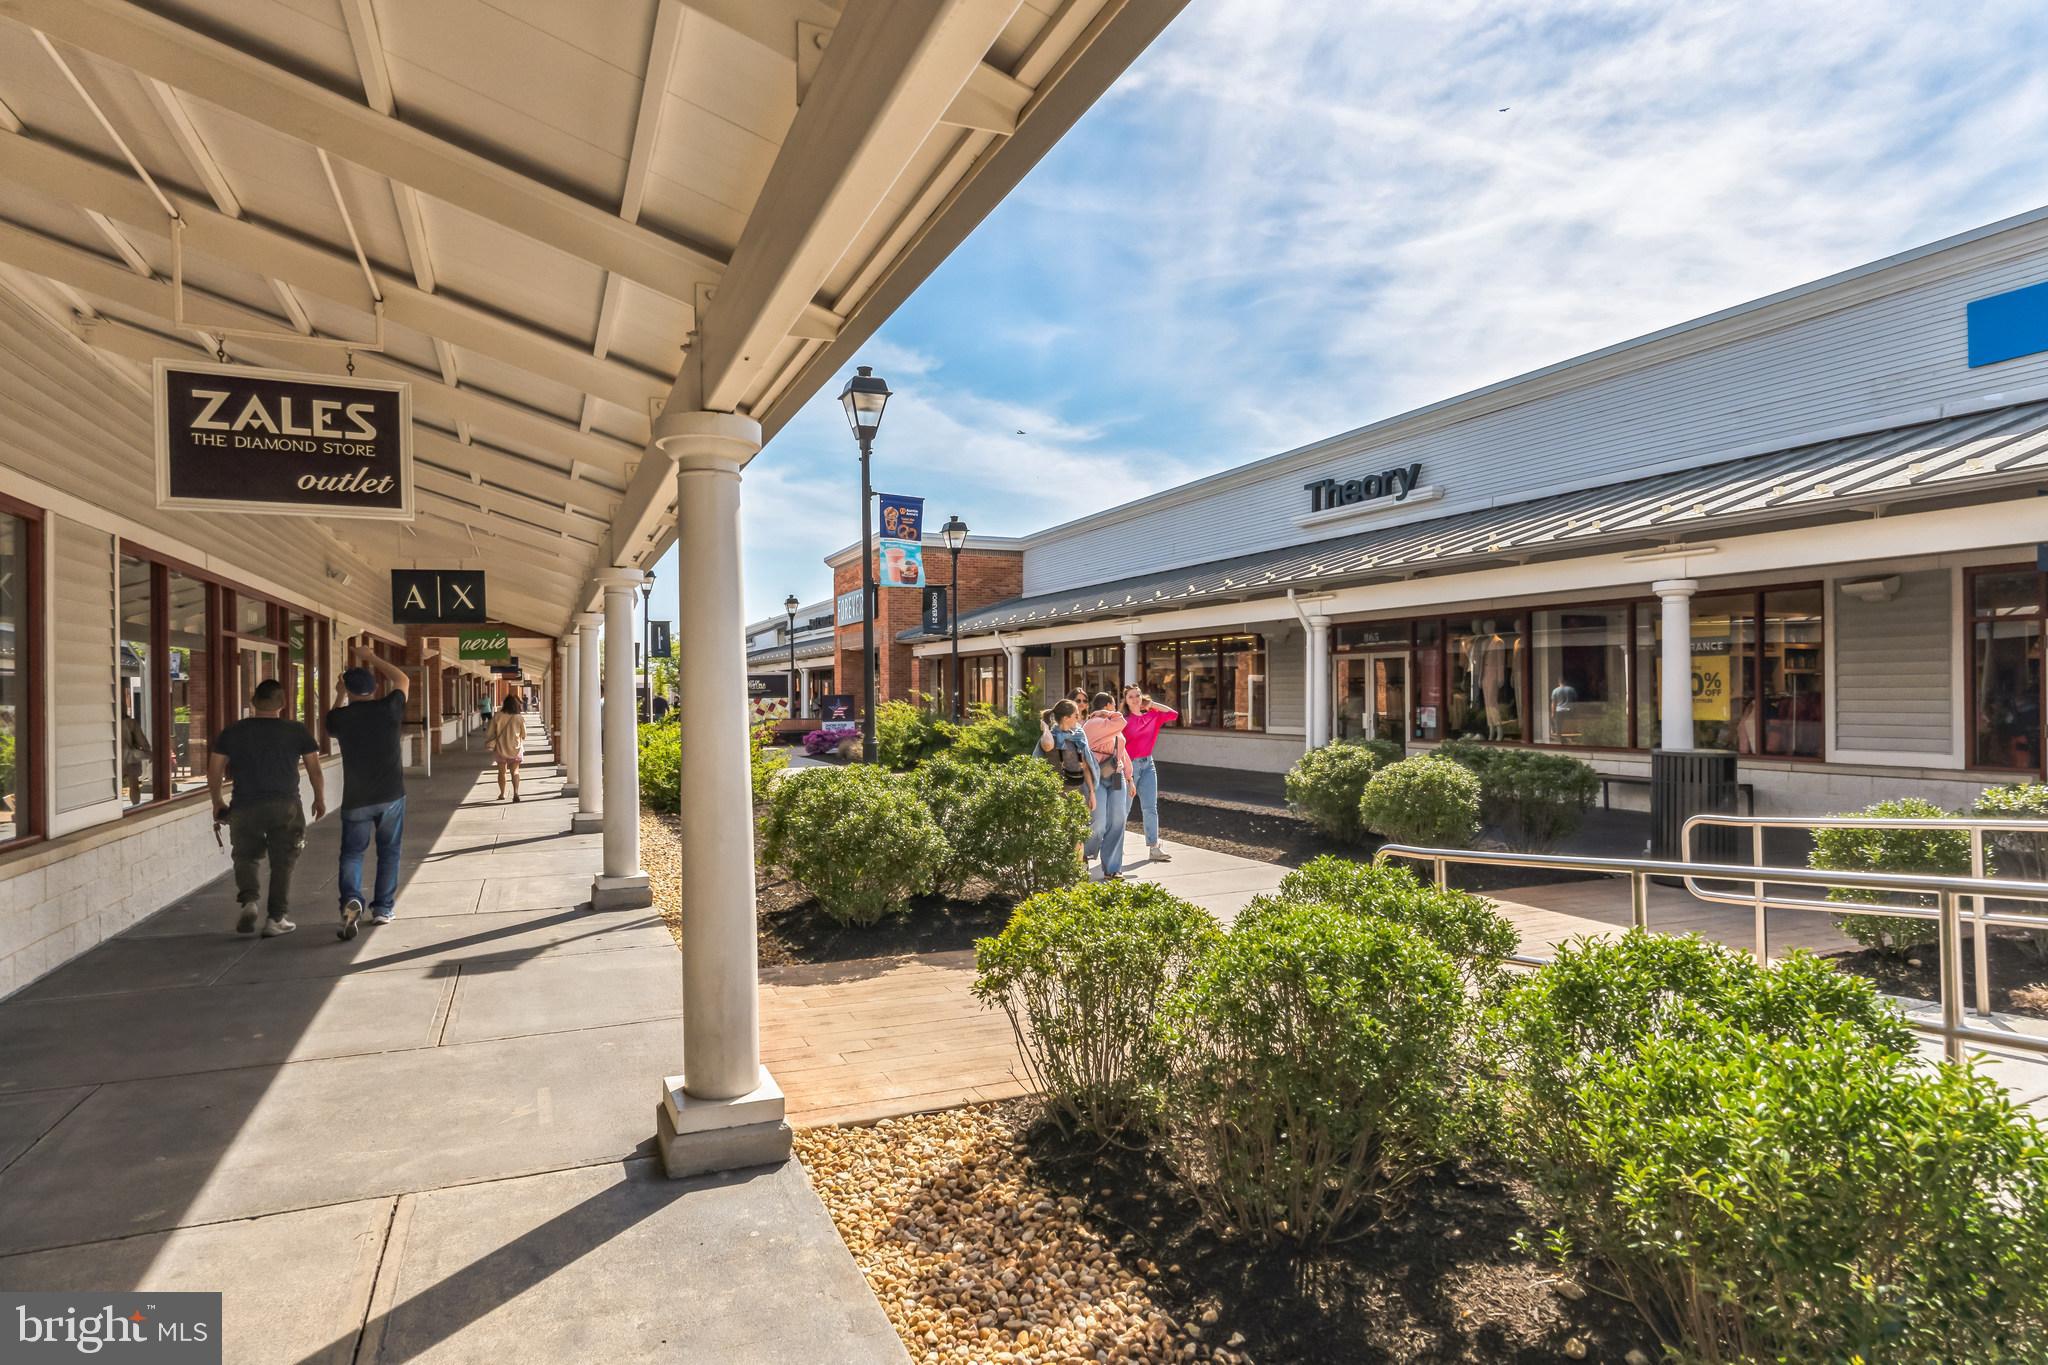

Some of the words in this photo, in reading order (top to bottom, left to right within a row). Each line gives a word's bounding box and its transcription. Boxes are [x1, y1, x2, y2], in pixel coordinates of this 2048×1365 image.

[190, 389, 377, 441] ZALES
[191, 433, 228, 447] THE
[235, 435, 317, 453] DIAMOND
[323, 441, 376, 457] STORE
[297, 467, 395, 494] outlet
[1303, 463, 1422, 513] Theory
[461, 633, 506, 651] aerie
[1690, 641, 1724, 651] RANCE
[1691, 672, 1722, 696] 0%
[1704, 688, 1722, 696] OFF
